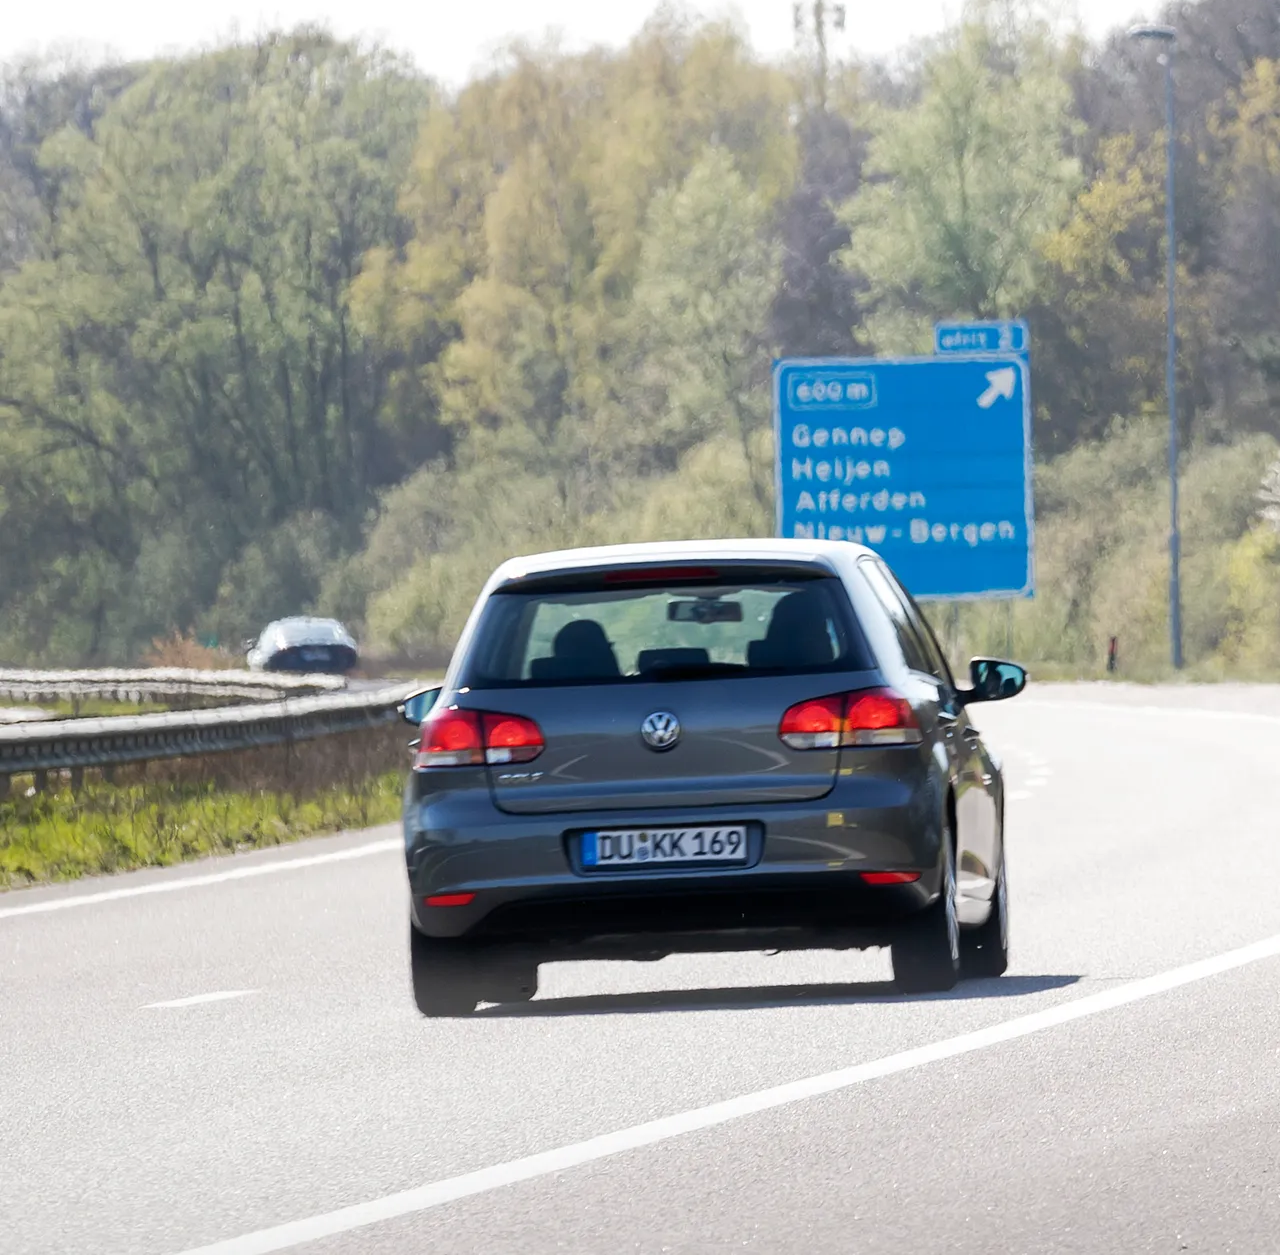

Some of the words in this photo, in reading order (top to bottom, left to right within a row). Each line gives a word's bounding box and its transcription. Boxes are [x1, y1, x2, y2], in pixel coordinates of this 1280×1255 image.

[796, 380, 843, 402] 600
[846, 382, 869, 401] m
[792, 423, 906, 451] Gennep
[792, 455, 891, 485] Heijen
[796, 488, 926, 514] Afferden
[599, 834, 634, 861] DU
[651, 831, 687, 858] KK
[692, 829, 742, 856] 169
